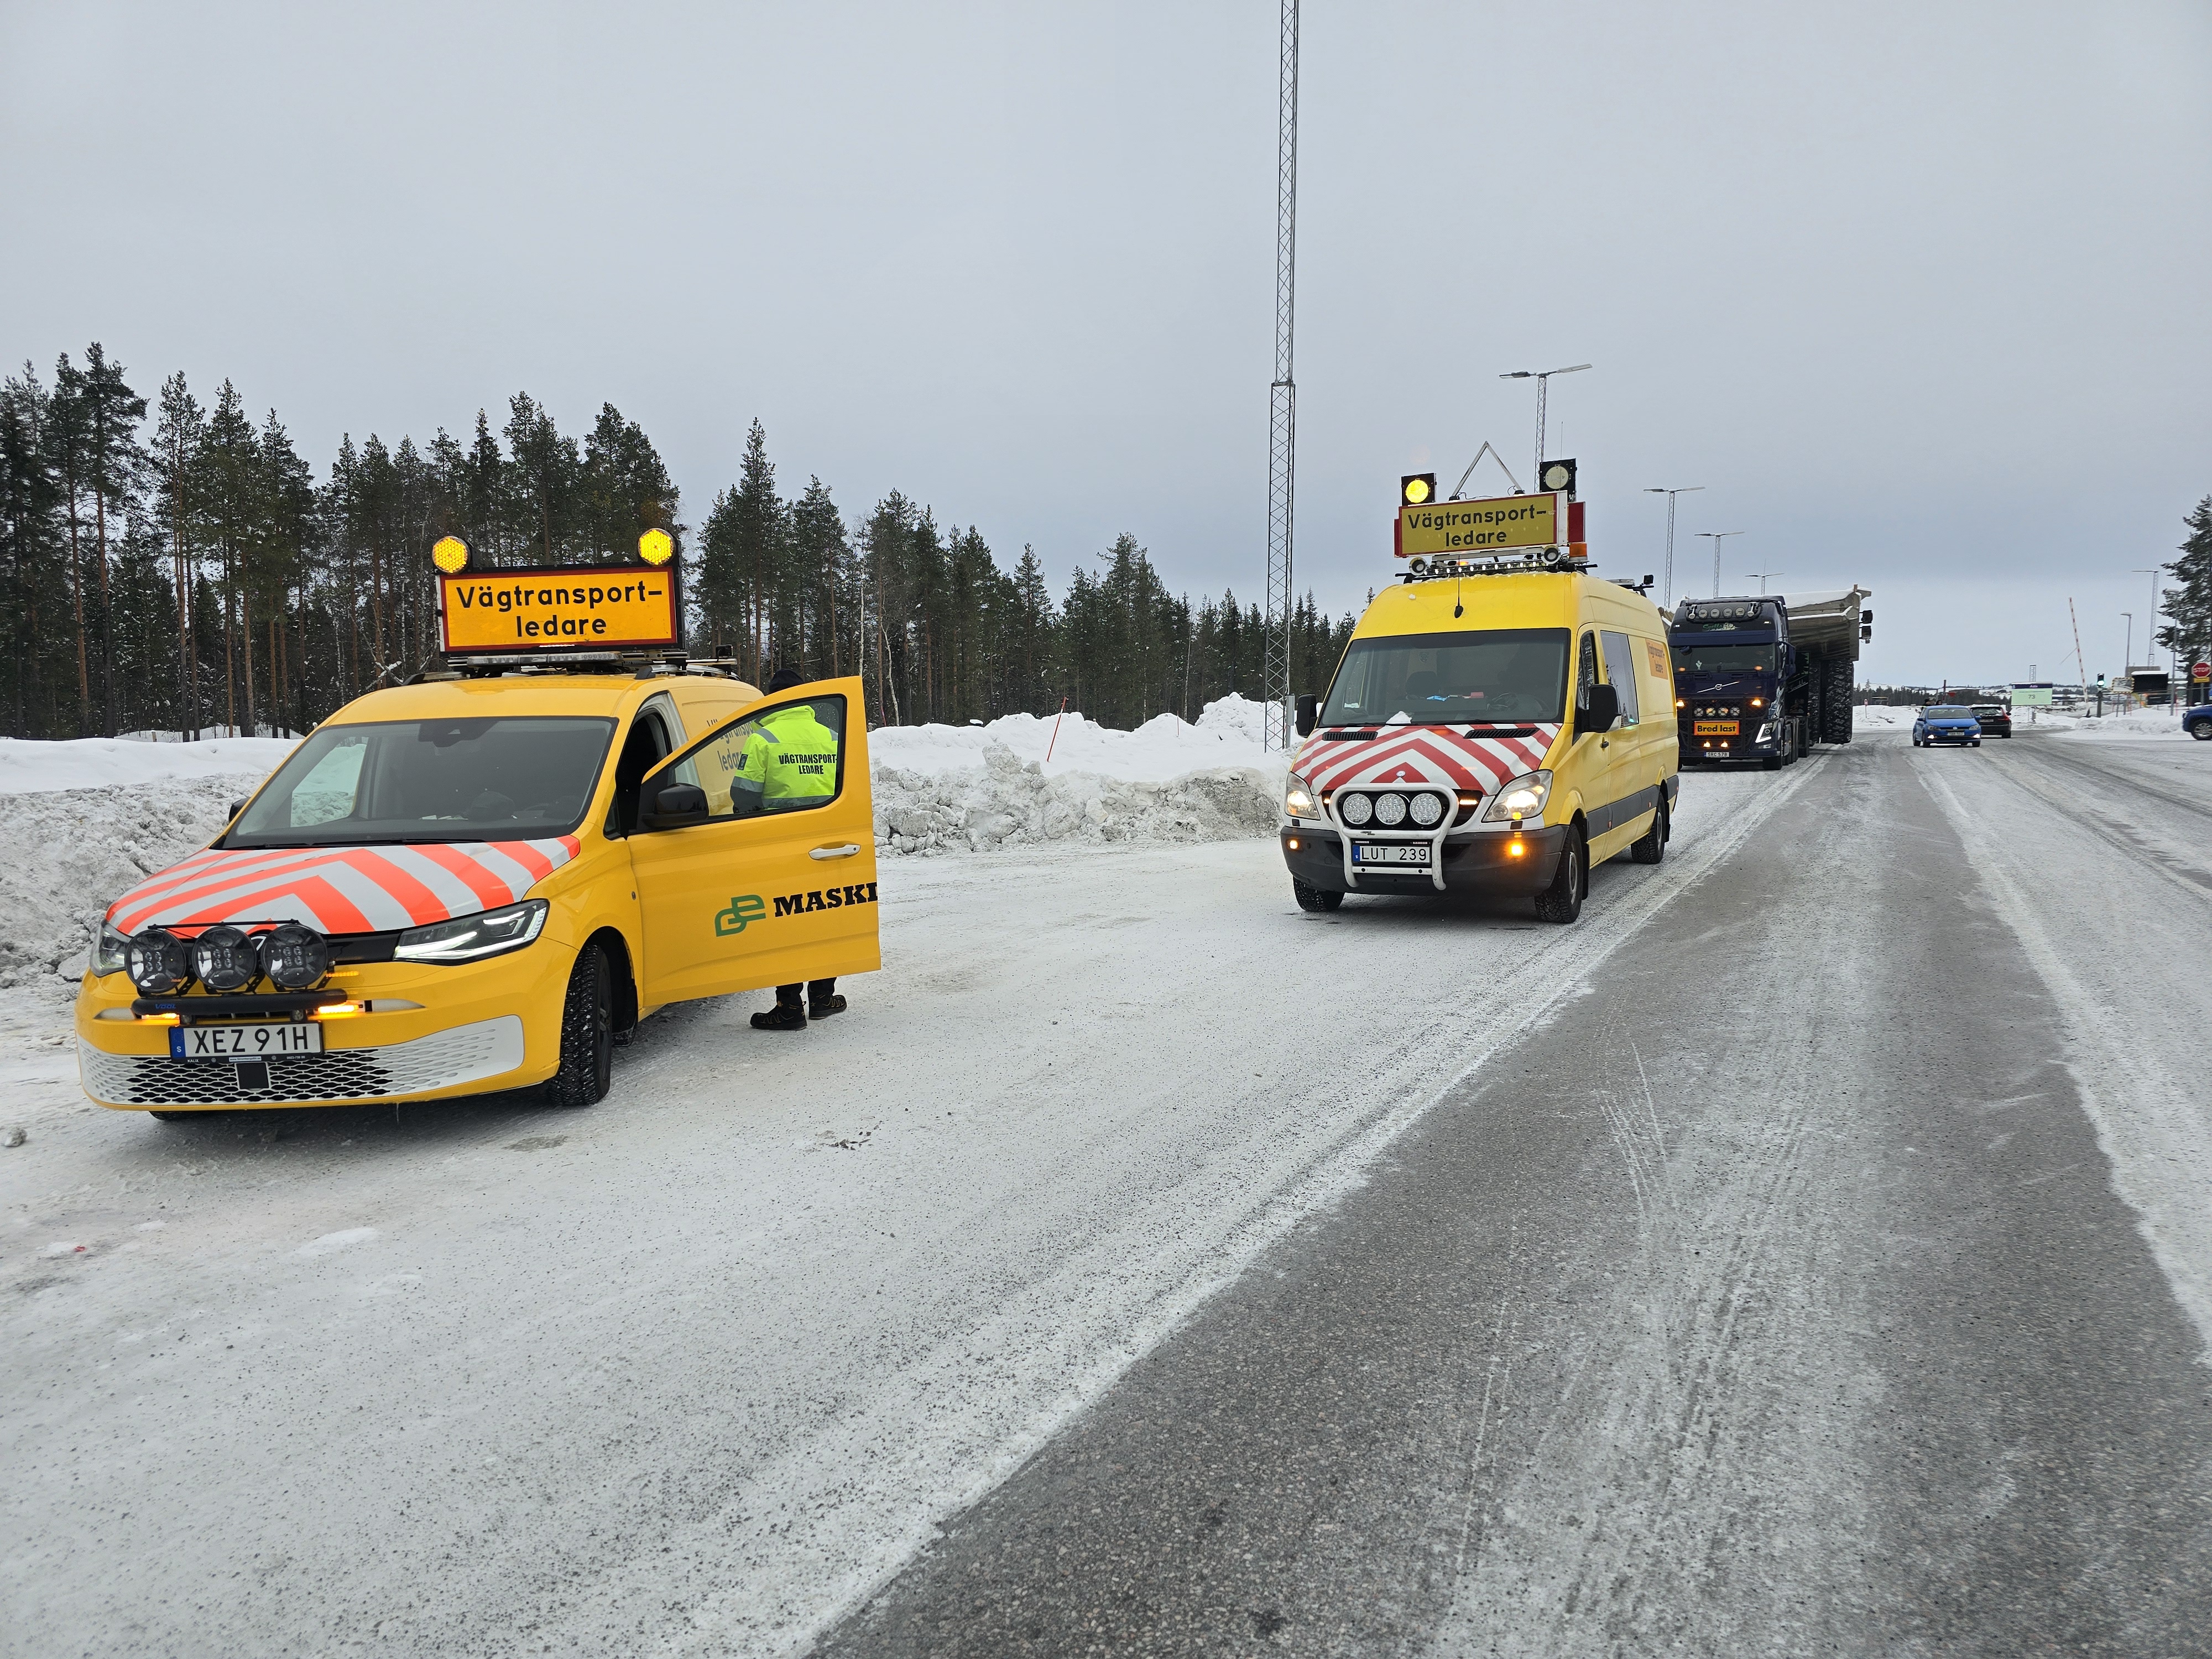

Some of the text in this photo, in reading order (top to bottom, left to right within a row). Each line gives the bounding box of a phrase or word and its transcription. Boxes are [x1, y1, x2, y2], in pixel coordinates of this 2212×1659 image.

[1408, 504, 1547, 530] Vägtransport-
[1446, 530, 1507, 547] ledare
[456, 581, 662, 612] Vägtransport-
[517, 615, 607, 637] ledare
[717, 749, 742, 772] ledar
[779, 753, 837, 765] VÄGTRANSPORT-
[799, 765, 824, 775] LEDARE
[1361, 847, 1426, 860] LUT 239
[194, 1026, 309, 1053] XEZ 91H
